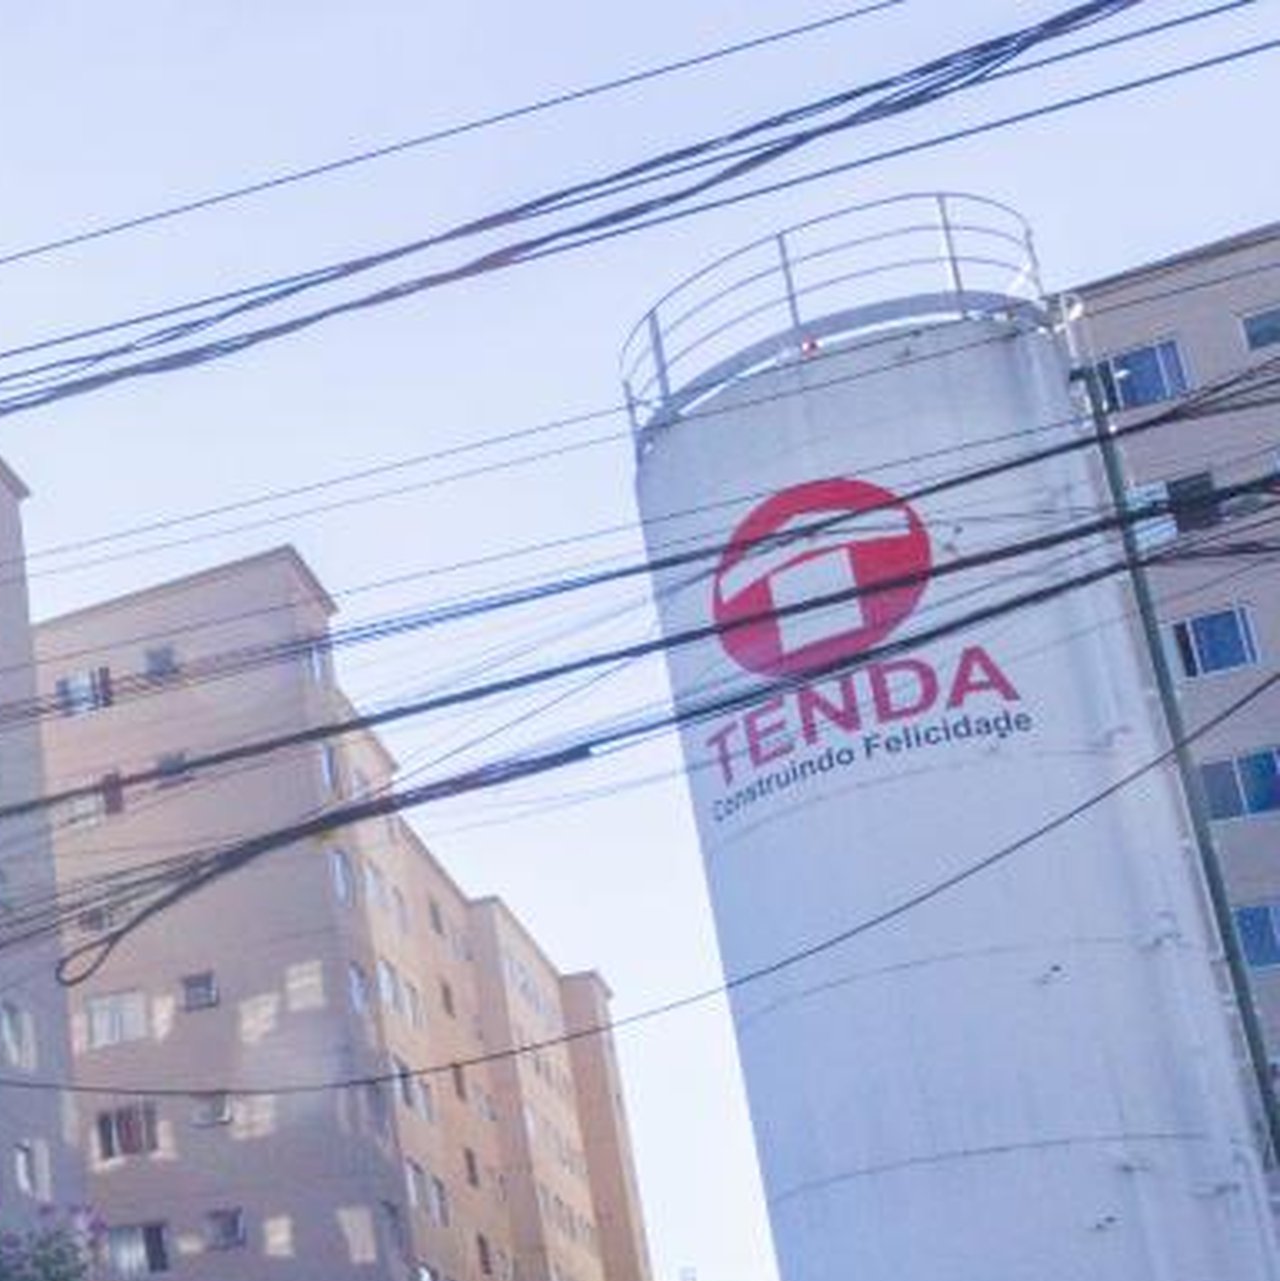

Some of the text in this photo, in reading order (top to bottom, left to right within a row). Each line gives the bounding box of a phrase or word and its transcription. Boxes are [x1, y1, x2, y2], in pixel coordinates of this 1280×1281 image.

[706, 646, 1021, 786] TENDA
[713, 708, 1033, 822] Construindo Felicidade
